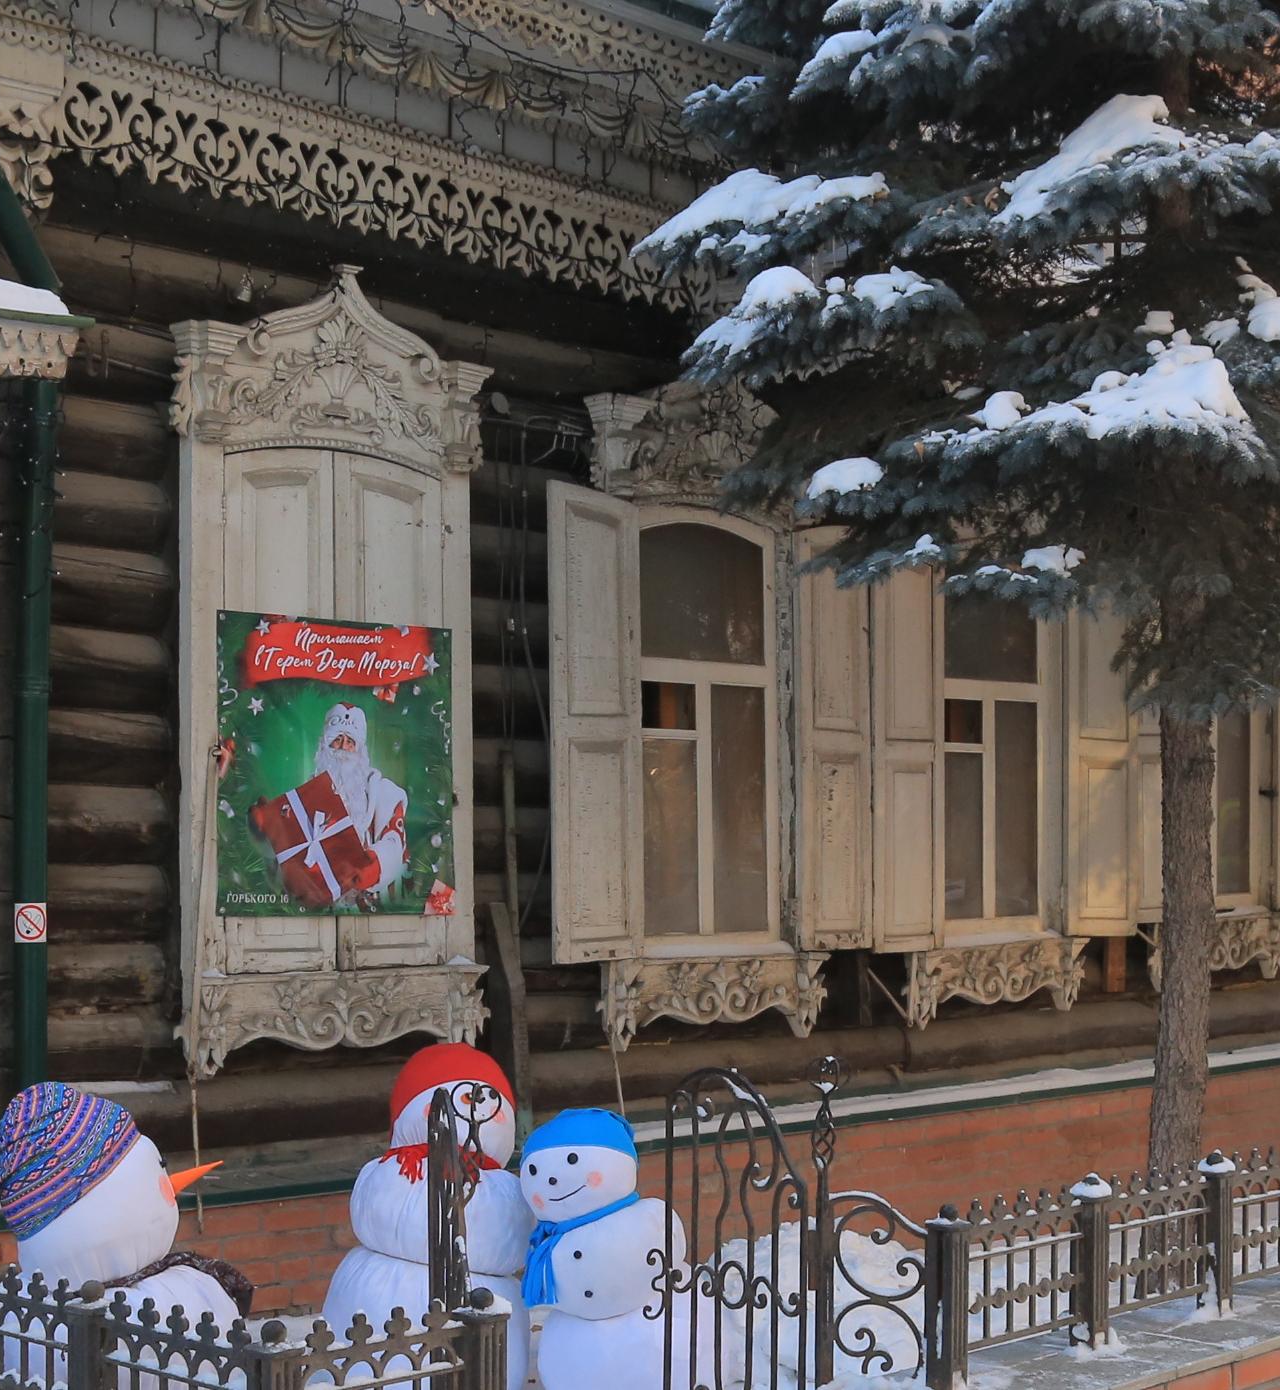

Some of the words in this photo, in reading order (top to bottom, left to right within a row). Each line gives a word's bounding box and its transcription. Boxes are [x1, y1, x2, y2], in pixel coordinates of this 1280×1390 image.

[294, 627, 384, 653] Приглашаем
[264, 647, 314, 676] Терем
[315, 647, 356, 680] Деда
[357, 651, 421, 679] Мороза!
[226, 892, 277, 904] ГОРЬКОГО
[280, 894, 289, 904] 16
